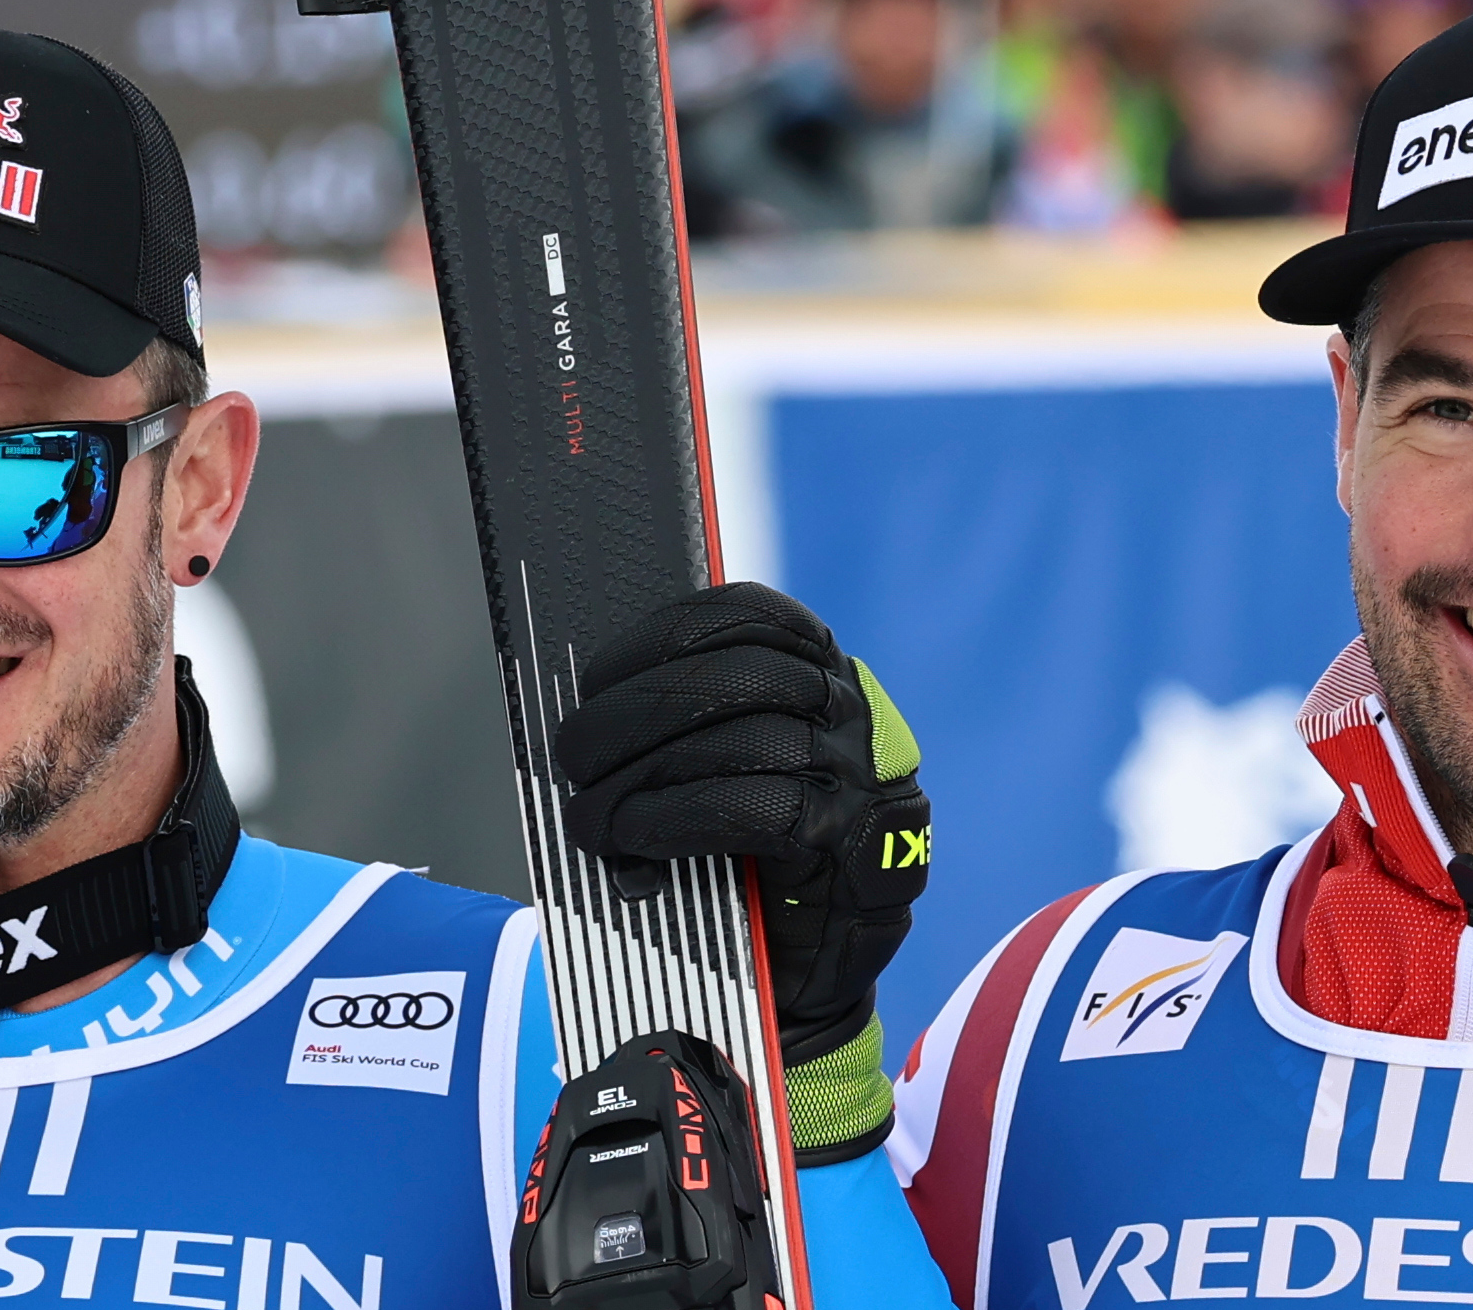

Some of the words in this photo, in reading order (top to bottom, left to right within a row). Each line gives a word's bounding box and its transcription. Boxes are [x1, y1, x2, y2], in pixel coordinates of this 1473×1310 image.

[546, 236, 560, 260] DC
[552, 301, 575, 371] GARA
[562, 380, 585, 455] MULTI
[143, 419, 165, 444] uvex
[1082, 989, 1201, 1023] FIS
[304, 1043, 342, 1053] Audi
[302, 1054, 327, 1063] FIS
[331, 1055, 354, 1064] Ski
[358, 1056, 406, 1066] World
[410, 1058, 440, 1071] Cup
[597, 1085, 628, 1104] 13
[589, 1099, 637, 1117] COMP
[589, 1142, 649, 1164] MARKER
